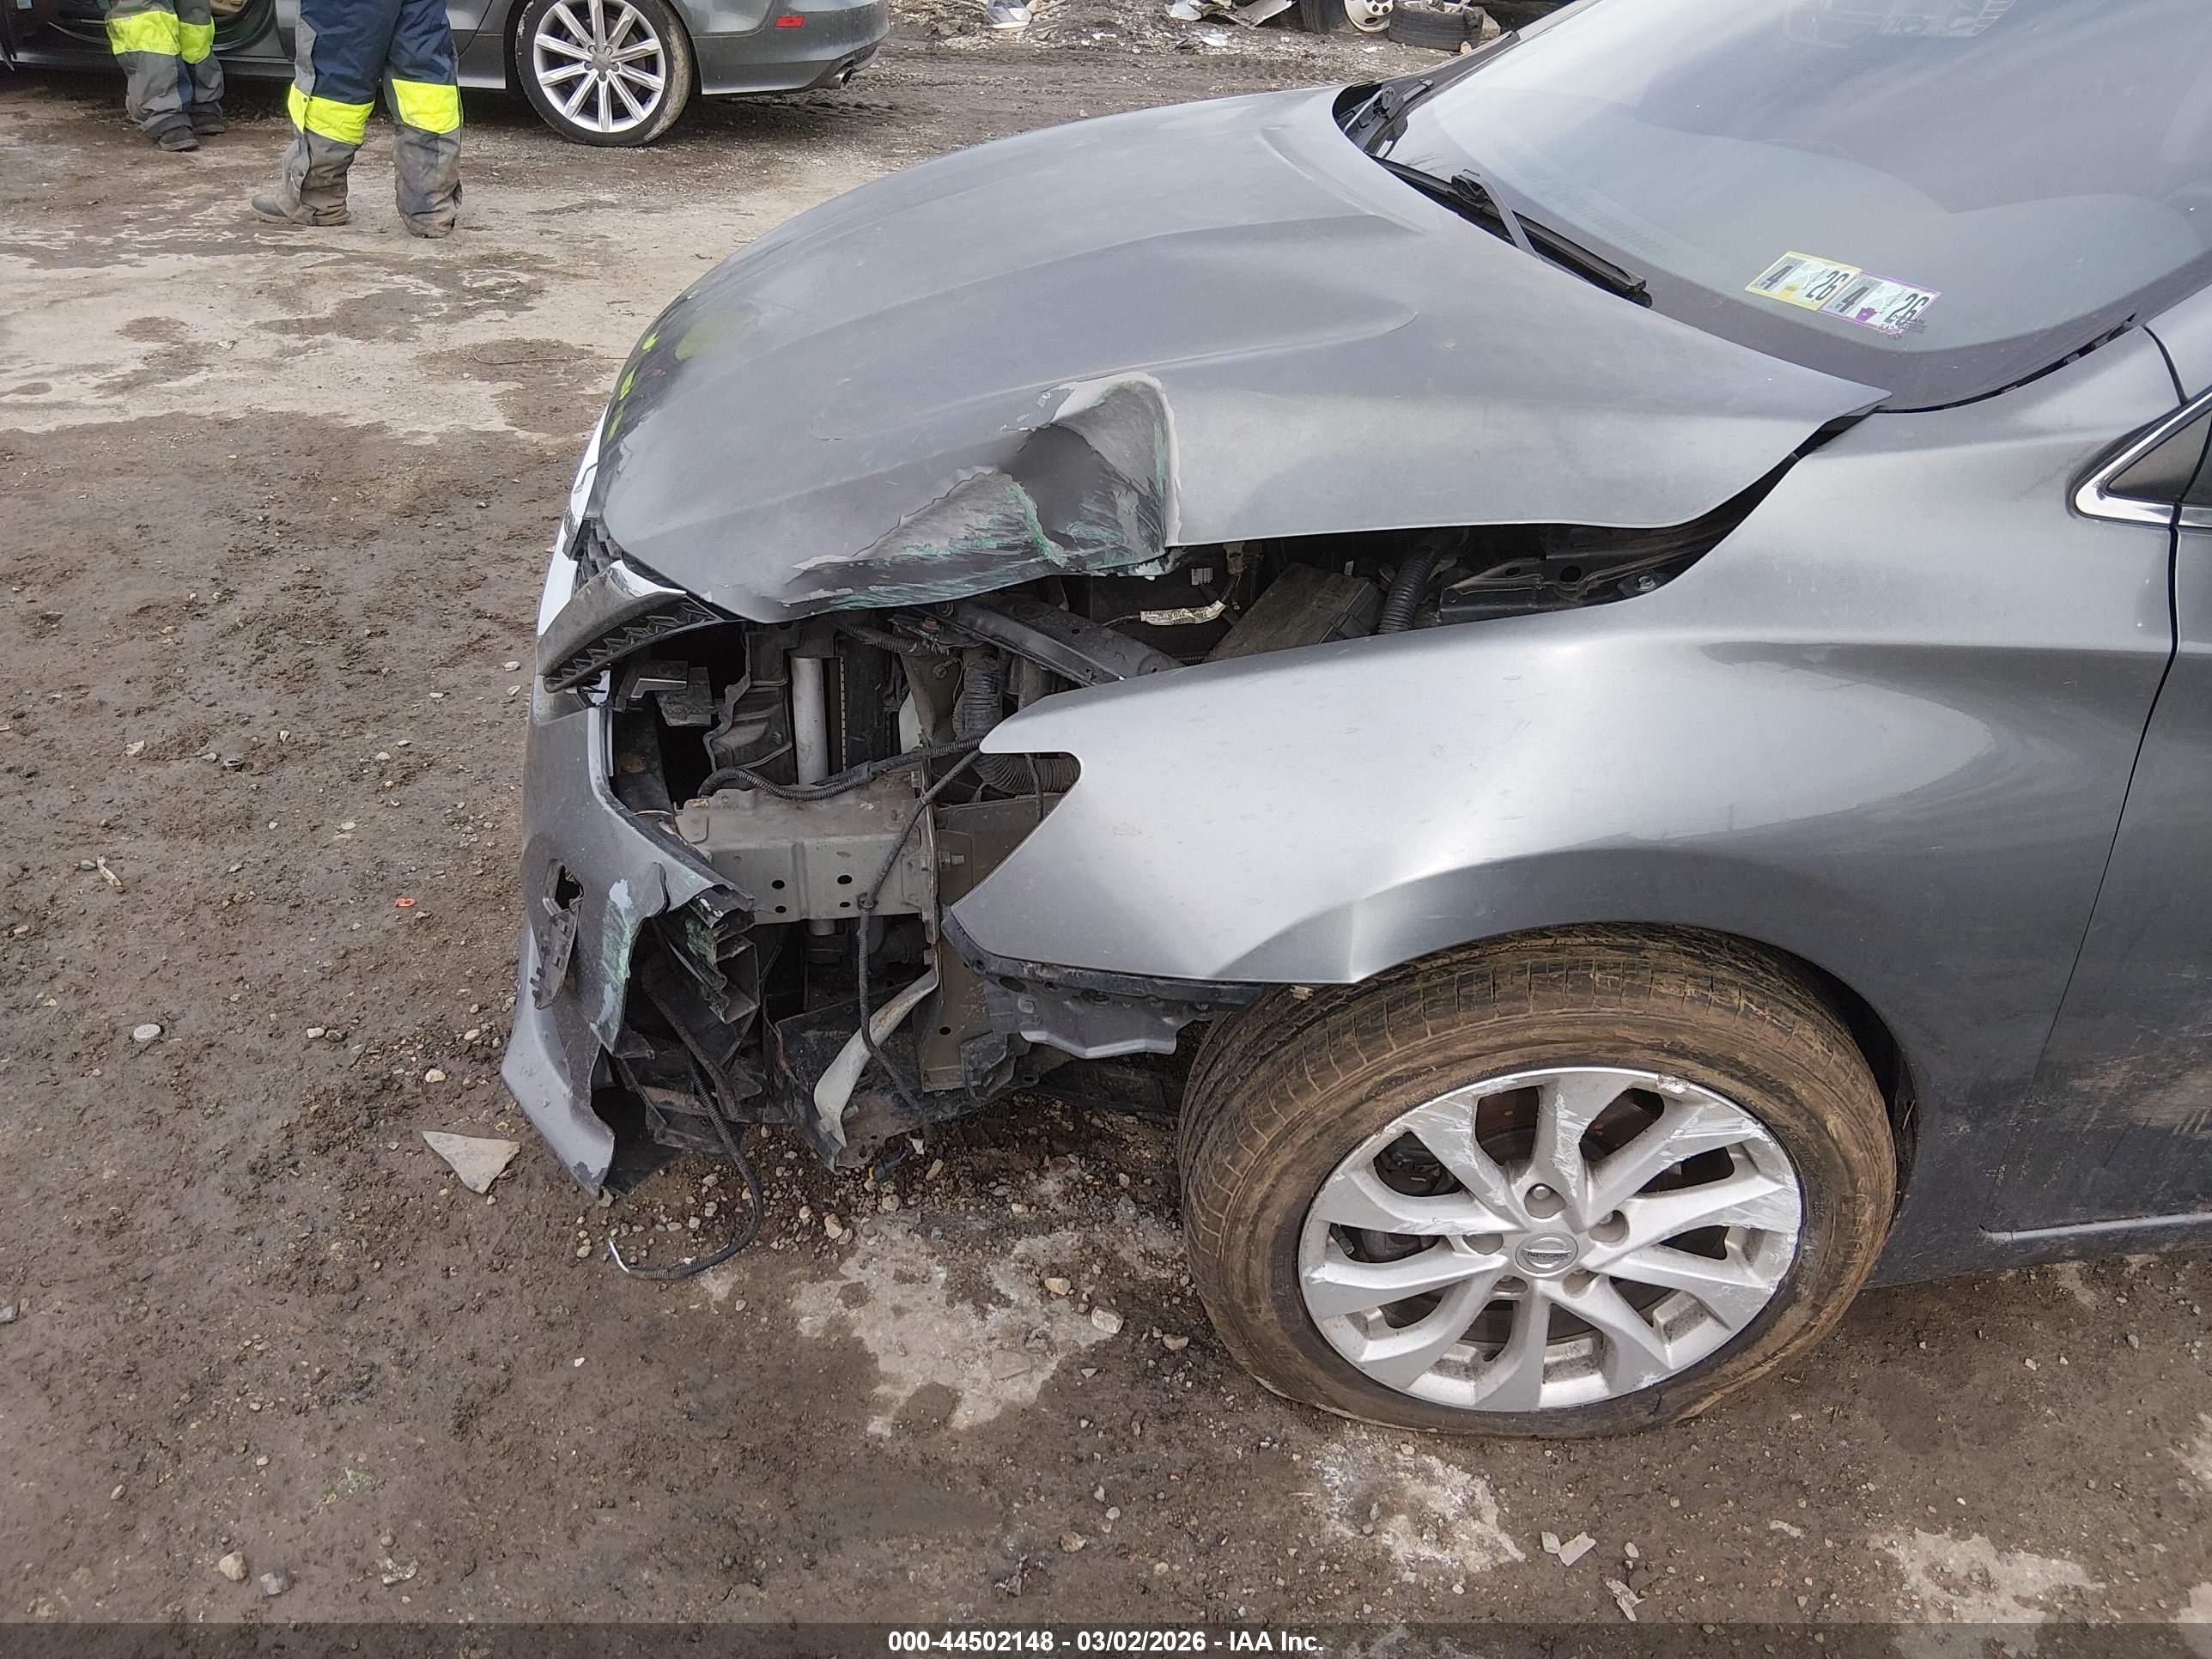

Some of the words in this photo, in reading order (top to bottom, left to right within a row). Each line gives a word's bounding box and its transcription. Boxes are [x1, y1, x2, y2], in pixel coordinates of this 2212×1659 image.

[1765, 264, 1794, 289] 4
[1805, 270, 1850, 301] 26
[1840, 286, 1870, 313] 4
[1883, 292, 1930, 325] 26
